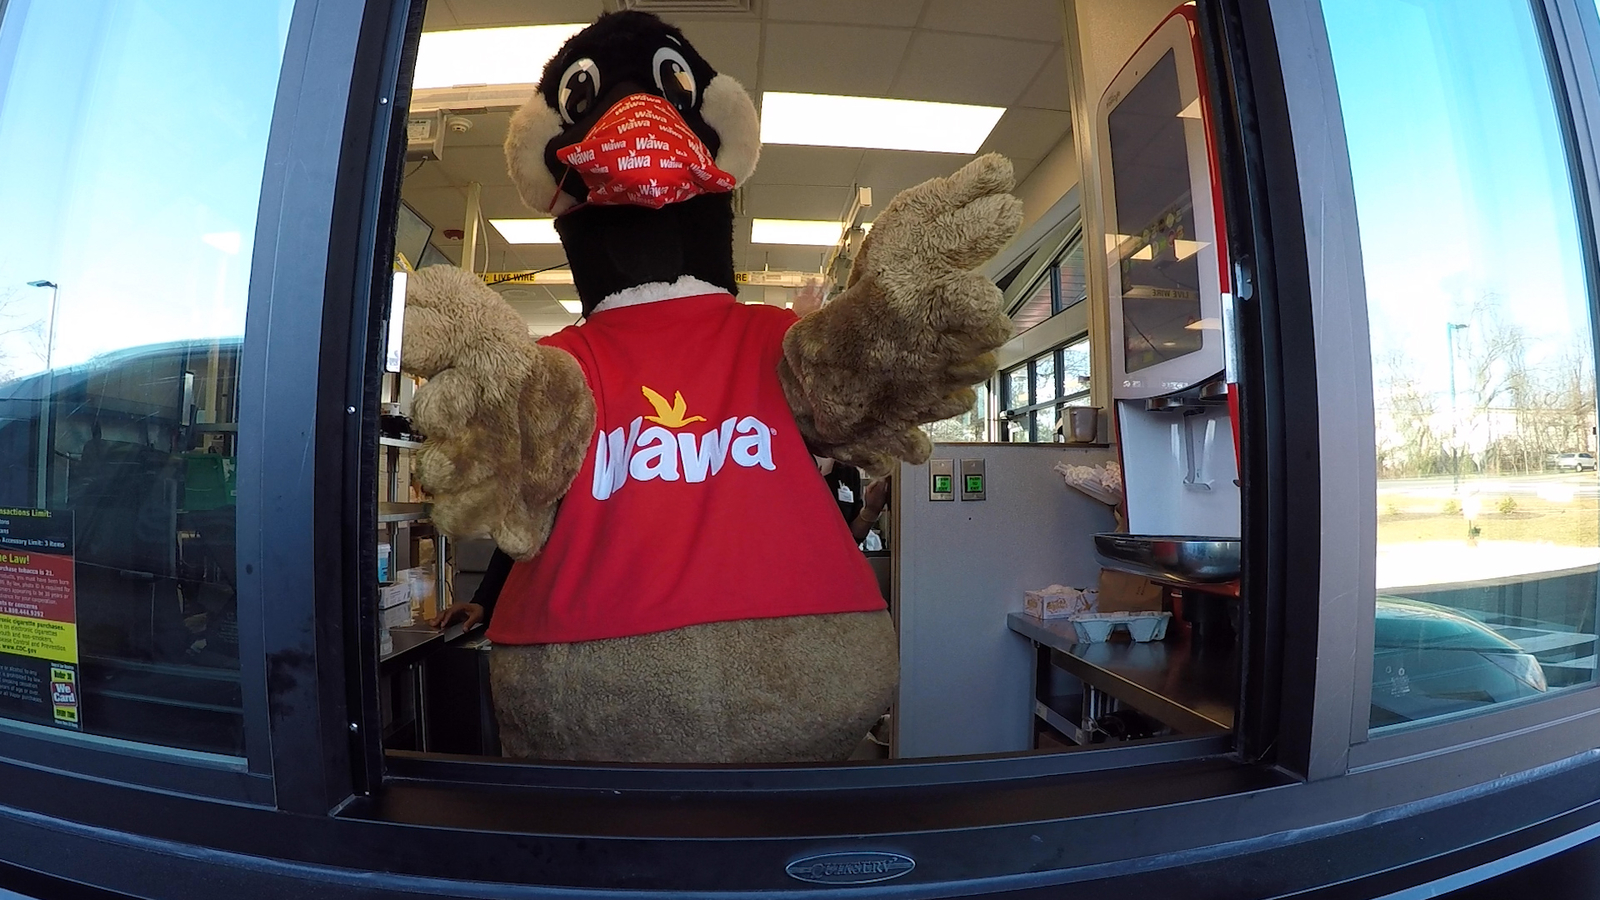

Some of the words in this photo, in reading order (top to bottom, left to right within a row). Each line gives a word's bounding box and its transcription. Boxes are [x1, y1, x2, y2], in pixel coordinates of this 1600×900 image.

[635, 110, 667, 123] Wawa
[617, 119, 651, 134] Wawa
[601, 140, 626, 152] Wawa
[636, 137, 670, 151] Wawa
[567, 149, 596, 165] Wawa
[617, 155, 651, 171] Wawa
[660, 158, 683, 169] Wawa
[494, 273, 511, 282] LIVE
[591, 415, 777, 501] Wawa
[31, 509, 52, 518] Limit:
[2, 537, 27, 546] Accessory
[9, 553, 30, 565] Law!
[18, 567, 38, 575] tobacco
[12, 618, 35, 627] cigarette
[55, 683, 72, 693] We
[53, 692, 76, 703] Card
